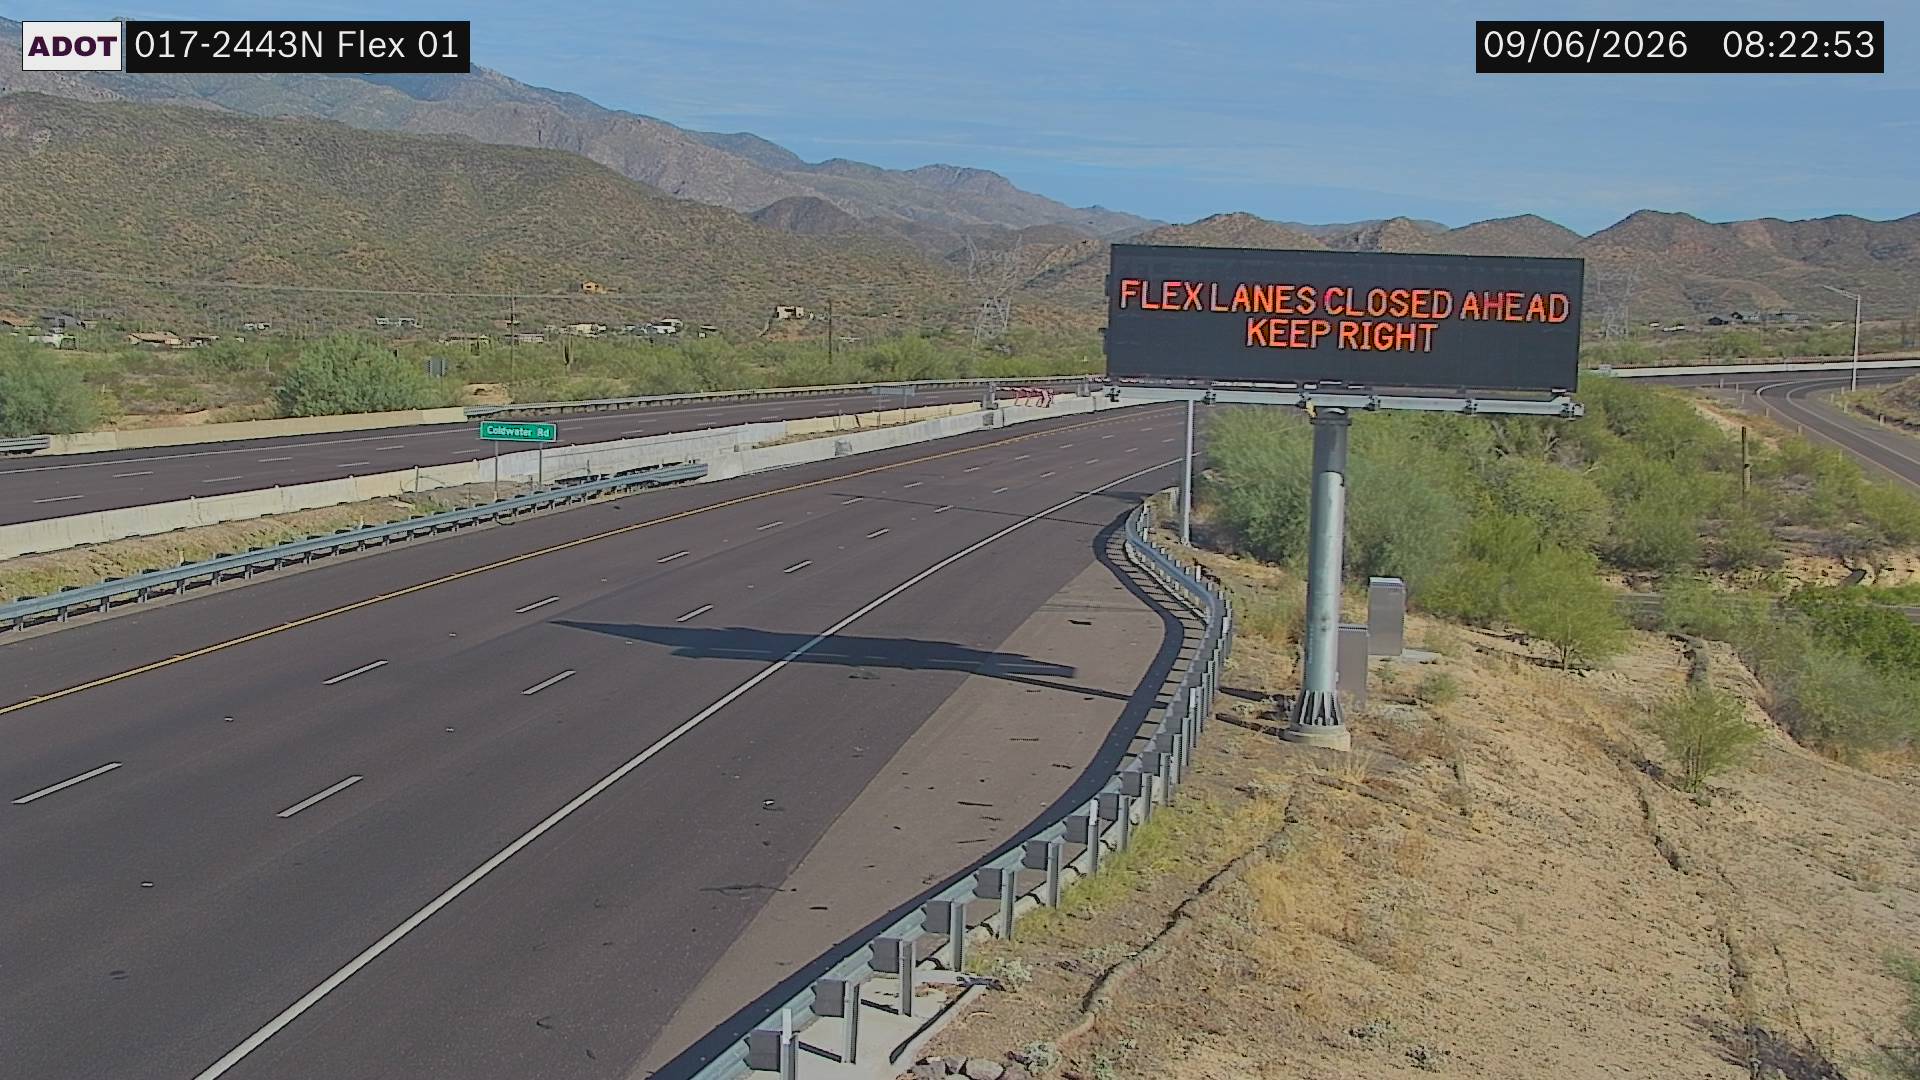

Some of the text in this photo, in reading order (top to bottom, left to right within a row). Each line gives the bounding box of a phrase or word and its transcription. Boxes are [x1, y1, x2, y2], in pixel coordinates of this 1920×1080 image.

[1120, 279, 1570, 323] FLEX LANES CLOSED AHEAD
[1246, 317, 1439, 353] KEEP RIGHT
[487, 425, 550, 438] Coldwater Rd
